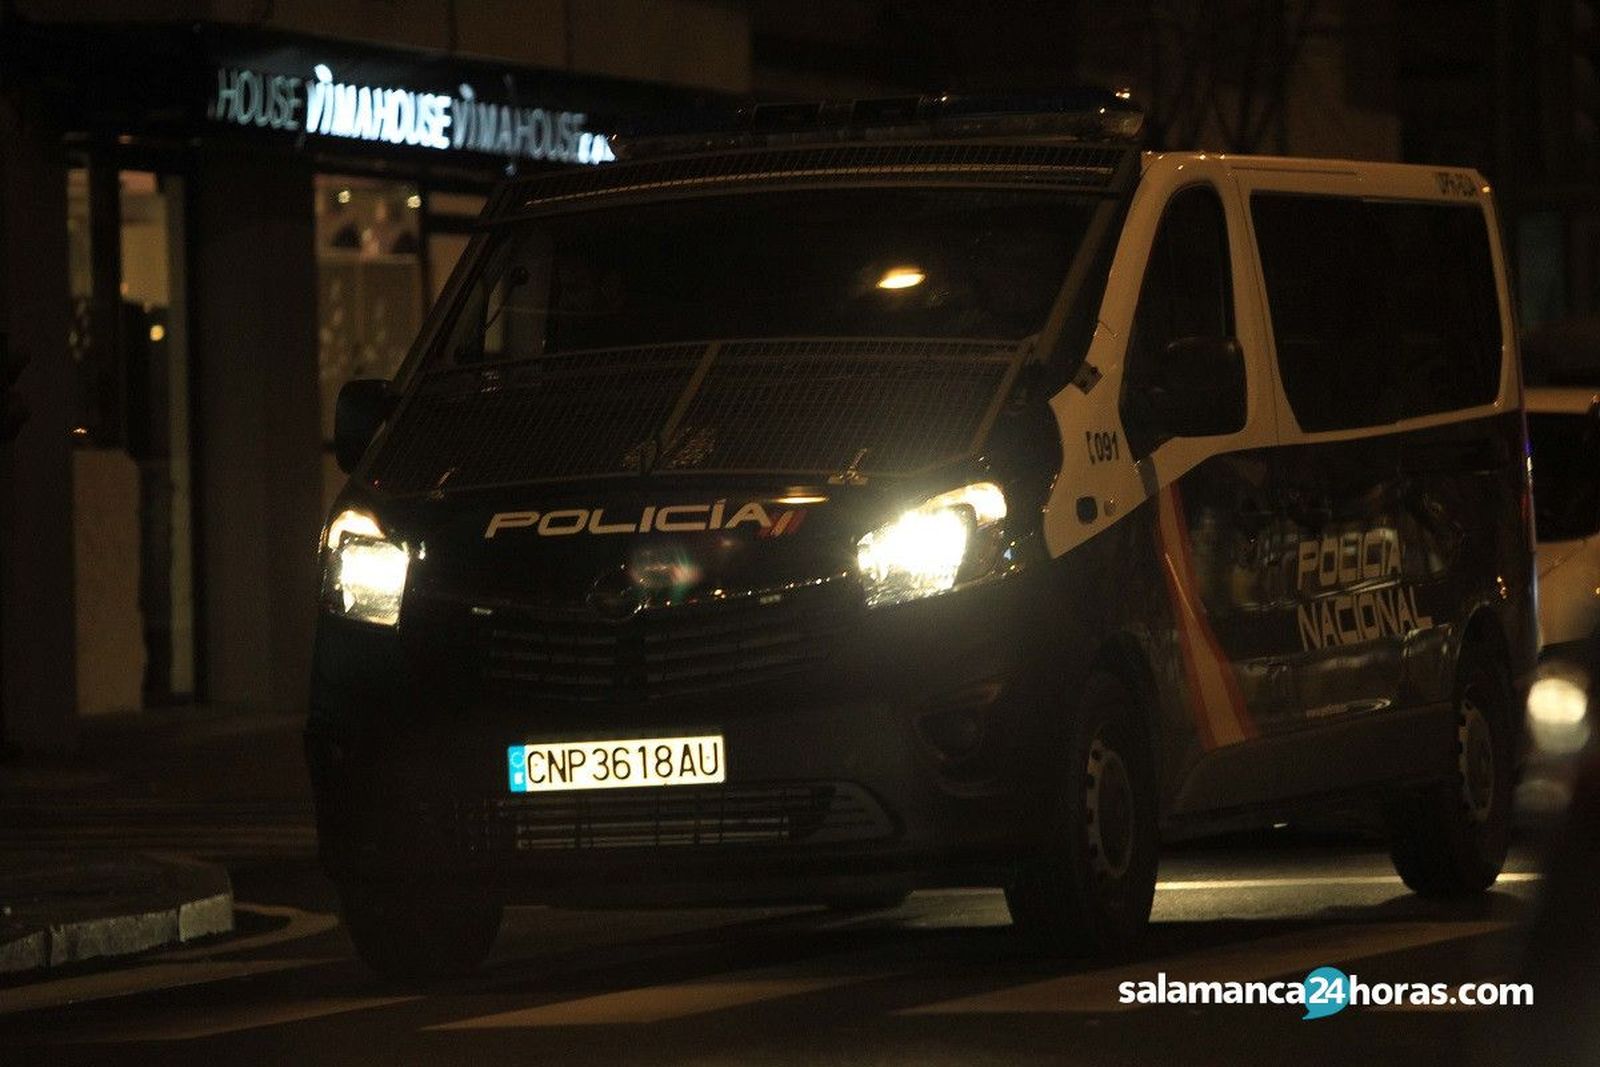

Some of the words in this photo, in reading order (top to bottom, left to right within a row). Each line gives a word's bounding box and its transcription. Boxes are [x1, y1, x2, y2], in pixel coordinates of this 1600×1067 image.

[1094, 431, 1119, 461] 091
[484, 499, 773, 539] POLICÍA
[1297, 584, 1433, 651] NACIONAL
